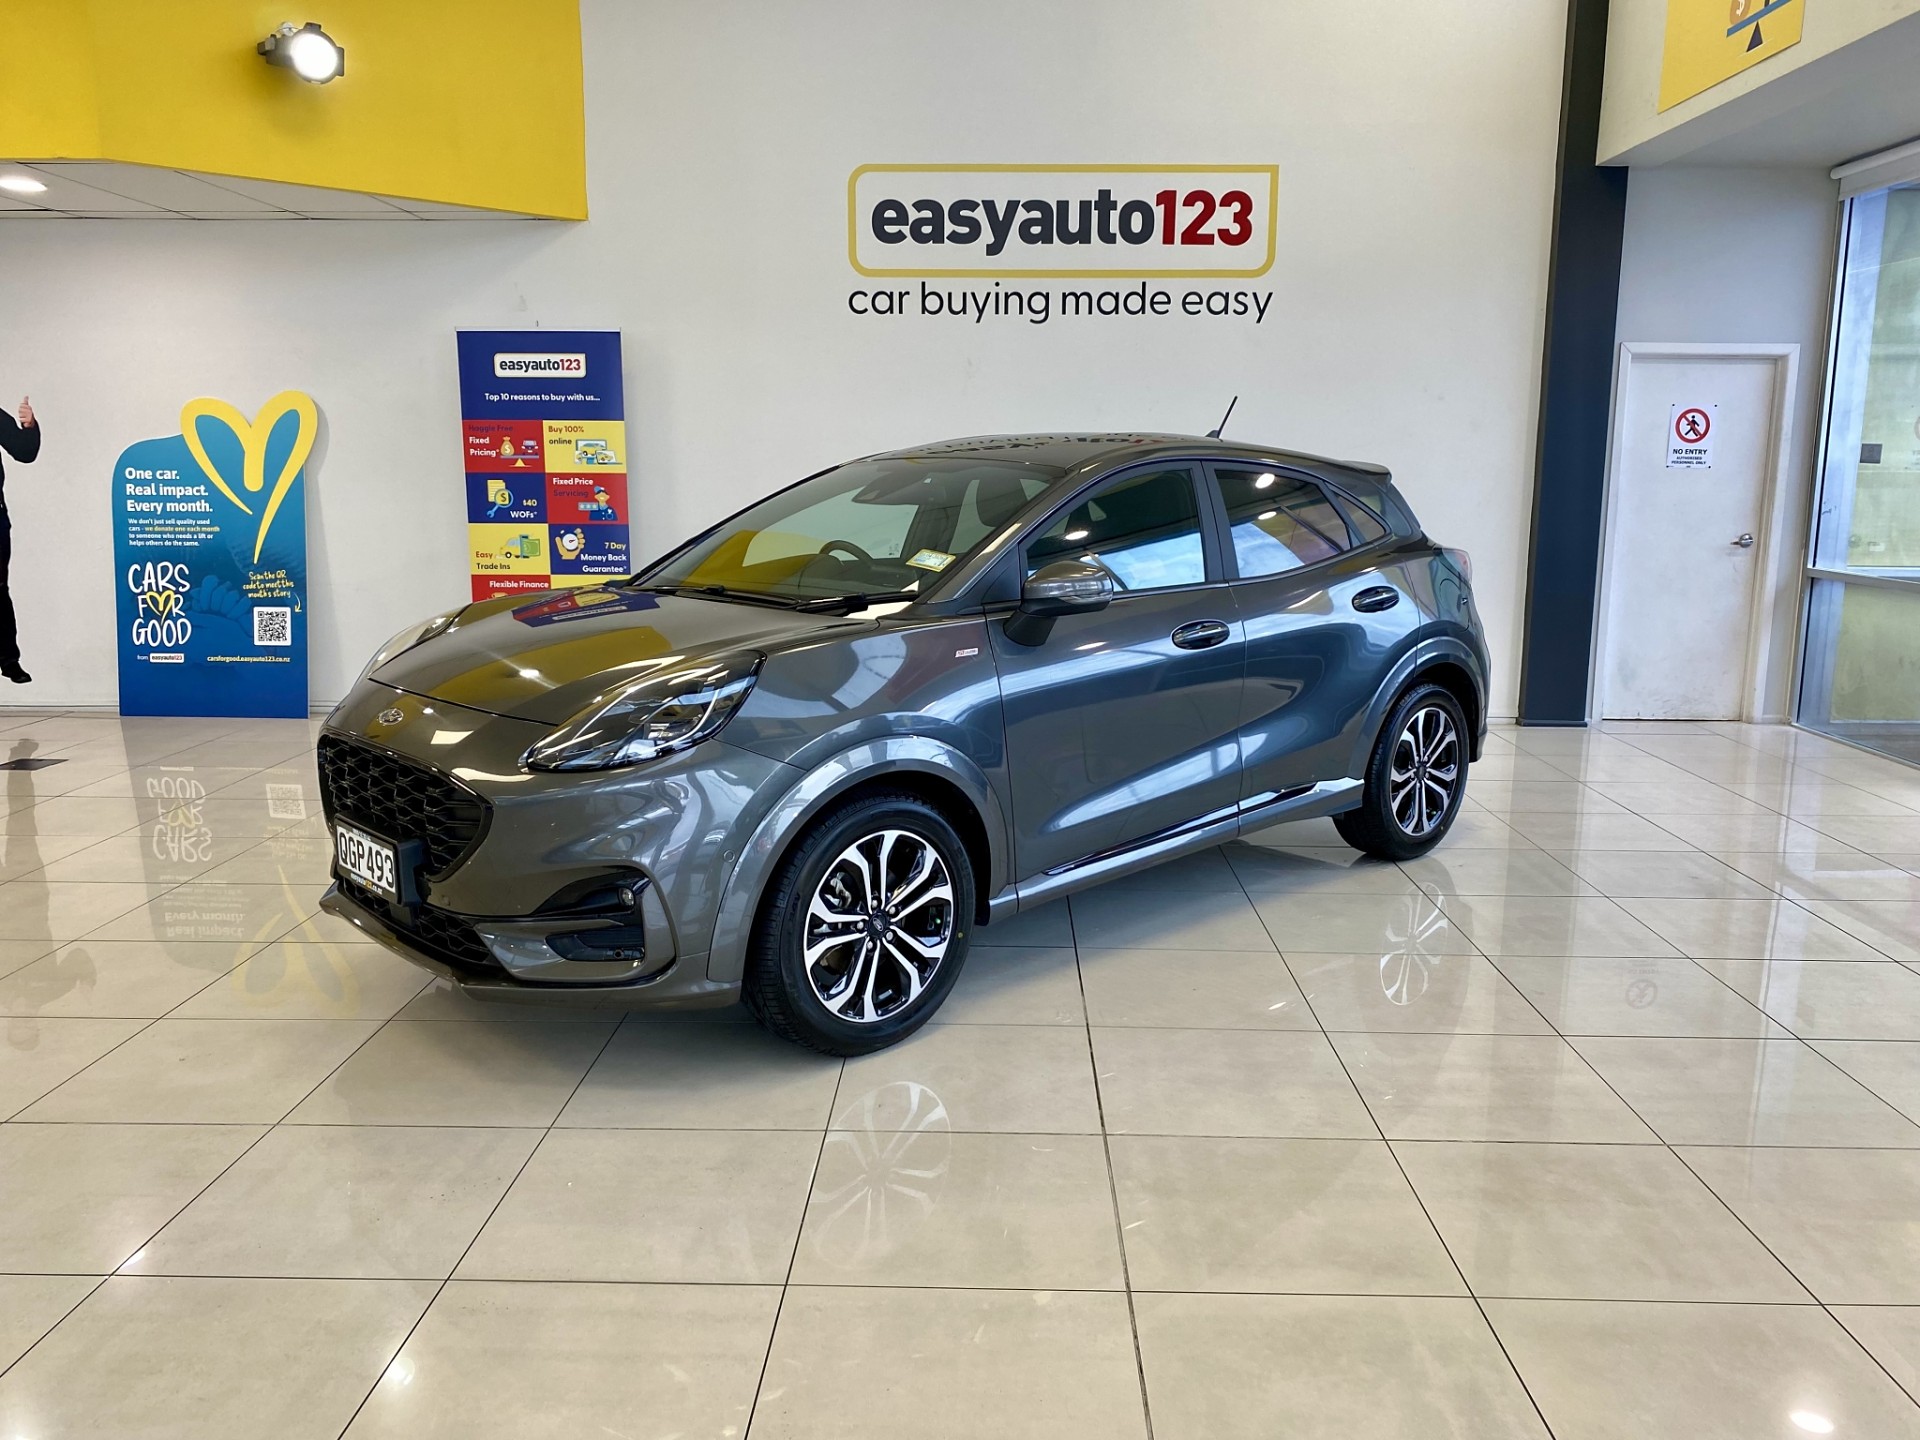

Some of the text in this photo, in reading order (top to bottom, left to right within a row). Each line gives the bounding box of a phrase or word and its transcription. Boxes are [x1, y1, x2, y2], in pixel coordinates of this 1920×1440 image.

[871, 188, 1254, 257] easyauto123
[848, 281, 1274, 325] car buying made easy
[499, 358, 581, 373] easyauto123
[484, 393, 499, 402] Top
[541, 393, 550, 401] to
[551, 393, 565, 402] buy
[566, 393, 585, 401] with
[468, 425, 495, 433] Haggle
[548, 425, 564, 434] Buy
[469, 436, 490, 444] Fixed
[548, 437, 572, 445] online
[125, 467, 180, 480] One car.
[552, 477, 574, 485] Fixed
[125, 482, 208, 499] Real impact.
[553, 489, 589, 498] Servicing
[126, 499, 213, 515] Every month.
[522, 499, 537, 507] $40
[153, 518, 165, 526] just
[176, 518, 196, 526] quality
[610, 542, 626, 551] Day
[475, 551, 493, 560] Easy
[580, 554, 627, 563] Money Back
[127, 561, 191, 593] CARS
[489, 580, 549, 588] Flexible Finance
[272, 588, 291, 599] story
[132, 617, 192, 648] GOOD
[339, 832, 395, 889] QGP493
